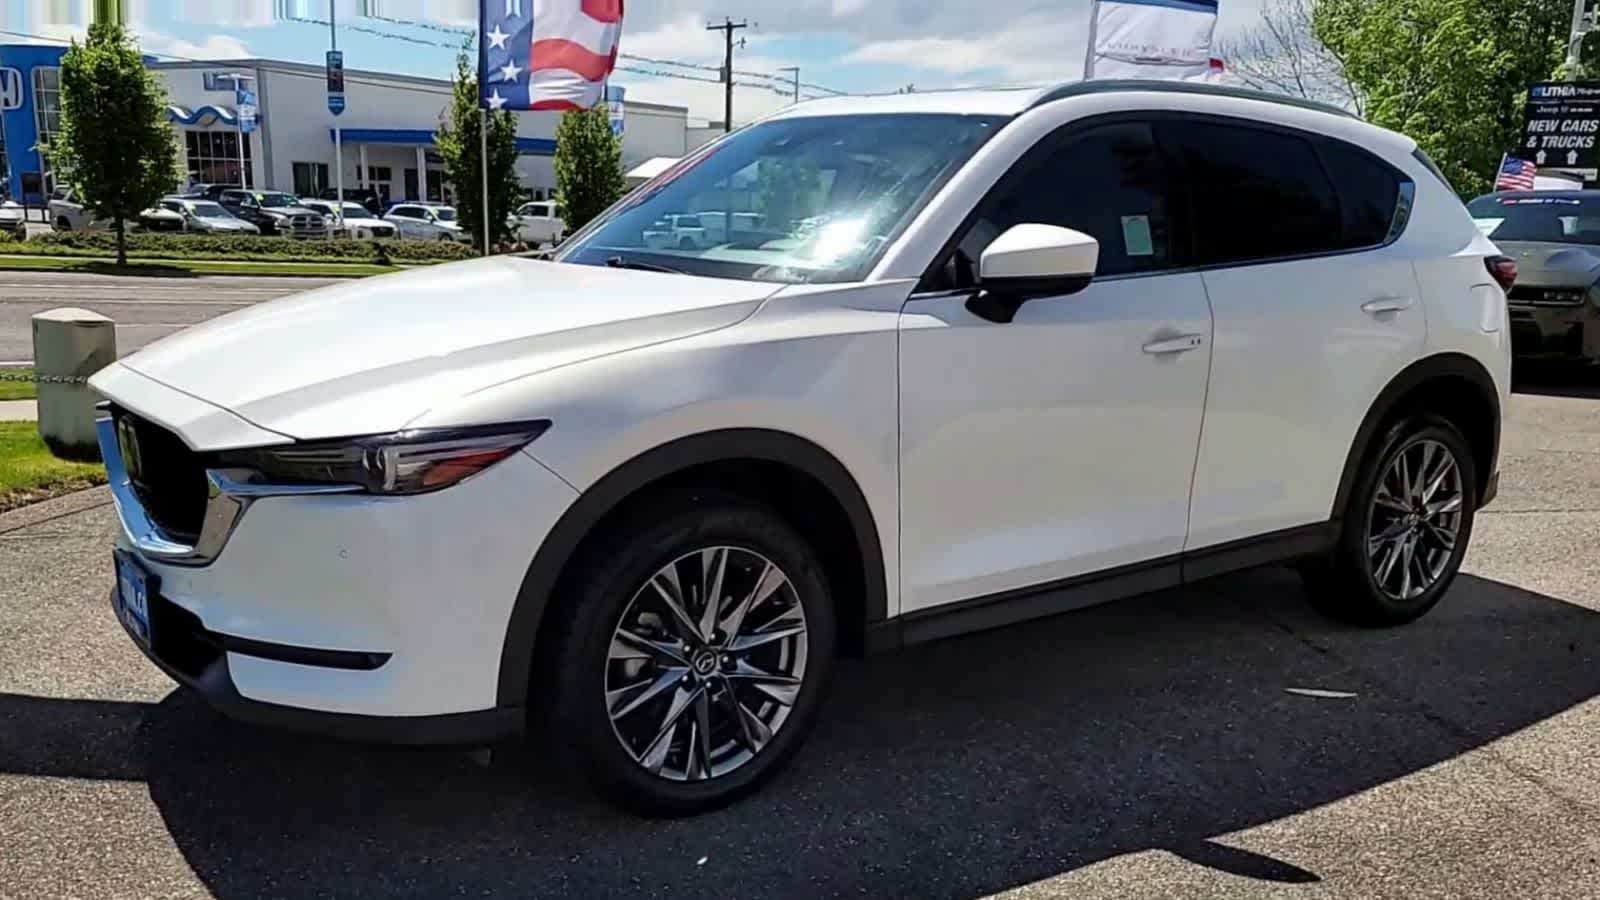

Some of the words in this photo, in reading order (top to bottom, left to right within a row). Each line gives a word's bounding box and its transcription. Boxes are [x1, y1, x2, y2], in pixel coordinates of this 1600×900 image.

[1541, 86, 1576, 97] LITHIA
[1527, 119, 1559, 132] NEW
[1561, 119, 1600, 132] CARS
[1526, 136, 1538, 148] &
[1541, 136, 1594, 148] TRUCKS
